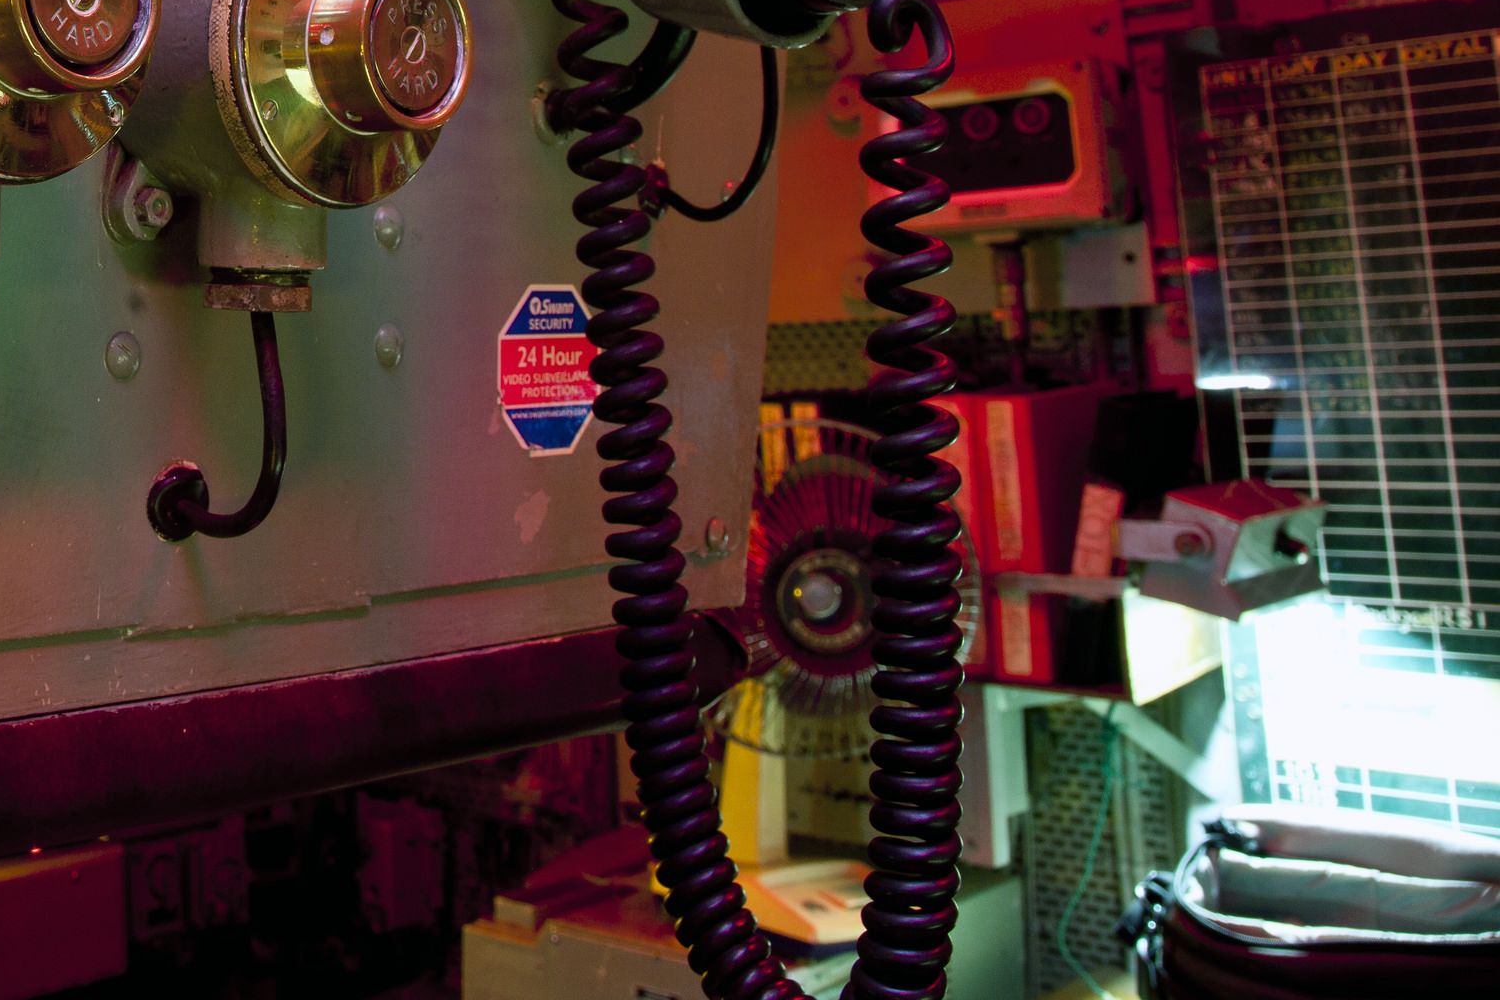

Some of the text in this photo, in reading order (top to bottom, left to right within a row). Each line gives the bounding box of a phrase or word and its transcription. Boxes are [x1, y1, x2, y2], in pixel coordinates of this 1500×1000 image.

[51, 7, 113, 48] HARD
[1333, 50, 1389, 75] DAY
[388, 57, 439, 96] HARD
[529, 318, 574, 330] SECURITY
[518, 345, 583, 367] 24 Hour
[503, 372, 532, 386] VIDEO
